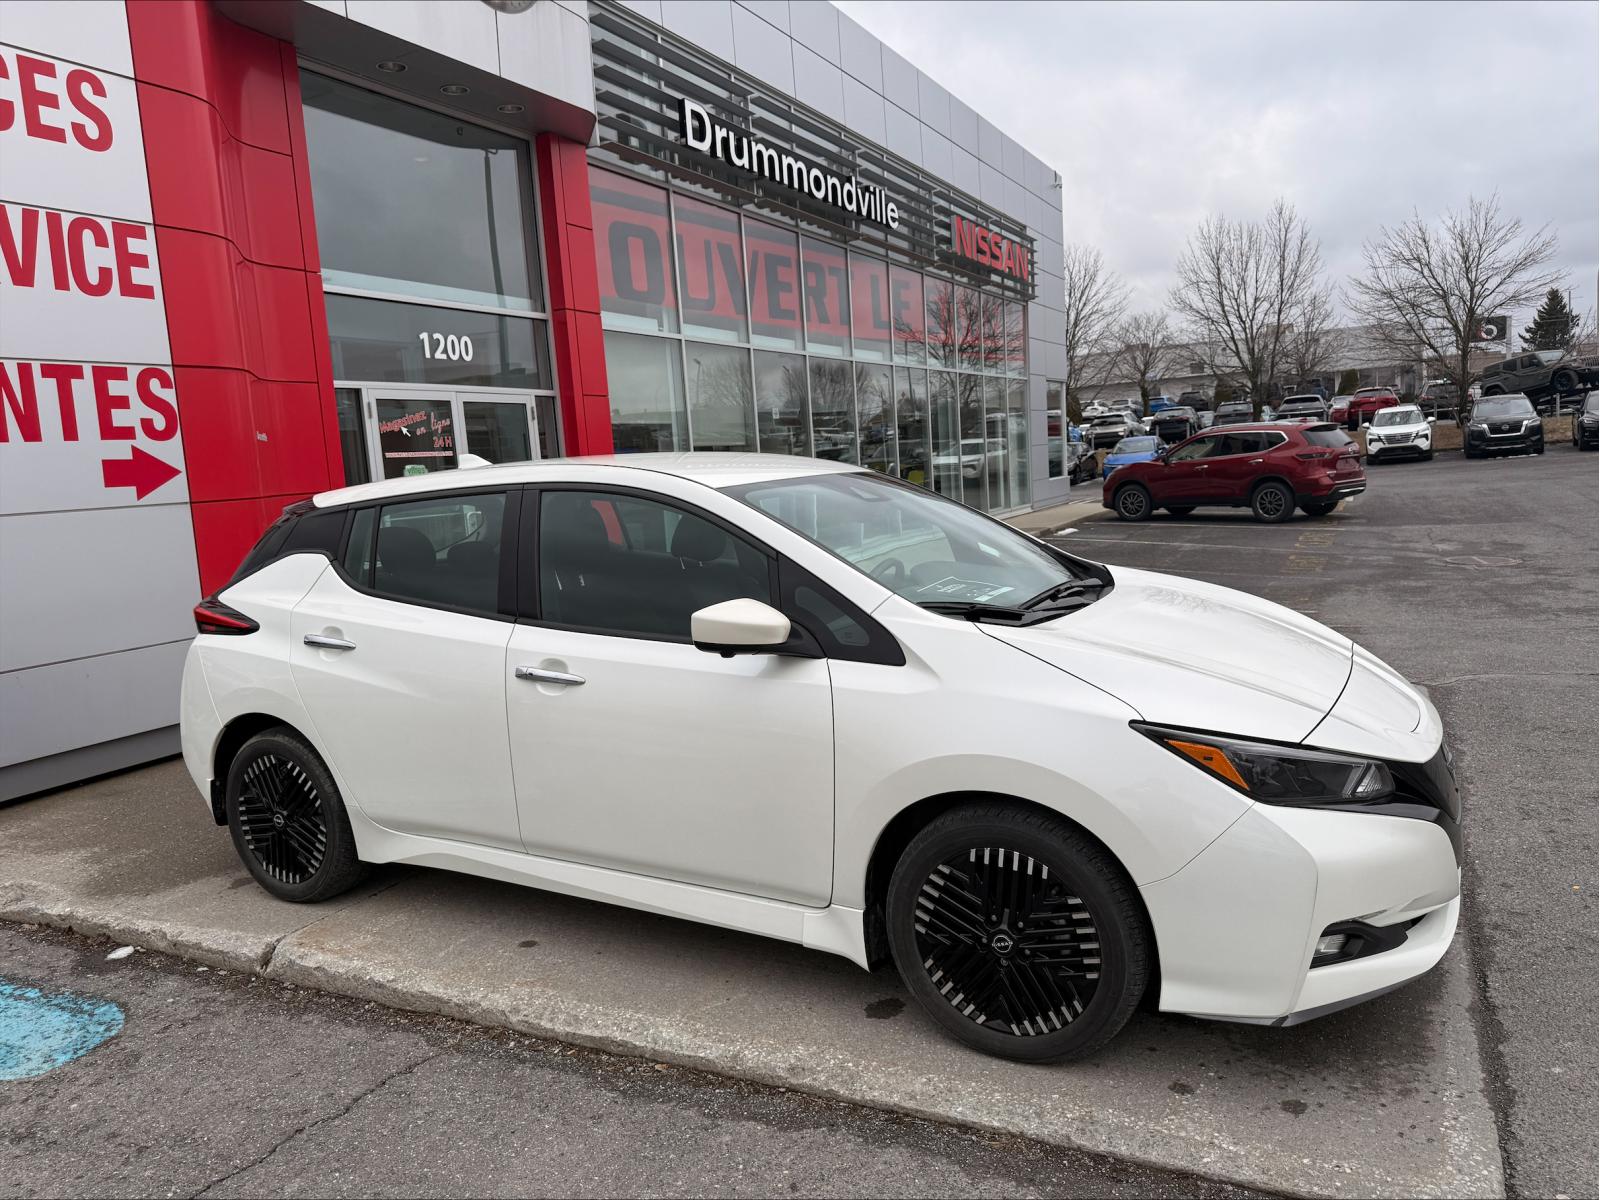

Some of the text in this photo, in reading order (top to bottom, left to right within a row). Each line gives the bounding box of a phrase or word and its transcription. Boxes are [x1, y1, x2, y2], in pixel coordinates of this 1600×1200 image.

[684, 98, 899, 230] Drummondville
[608, 220, 854, 326] OUVERT
[955, 215, 1029, 281] NISSAN
[419, 332, 473, 361] 1200
